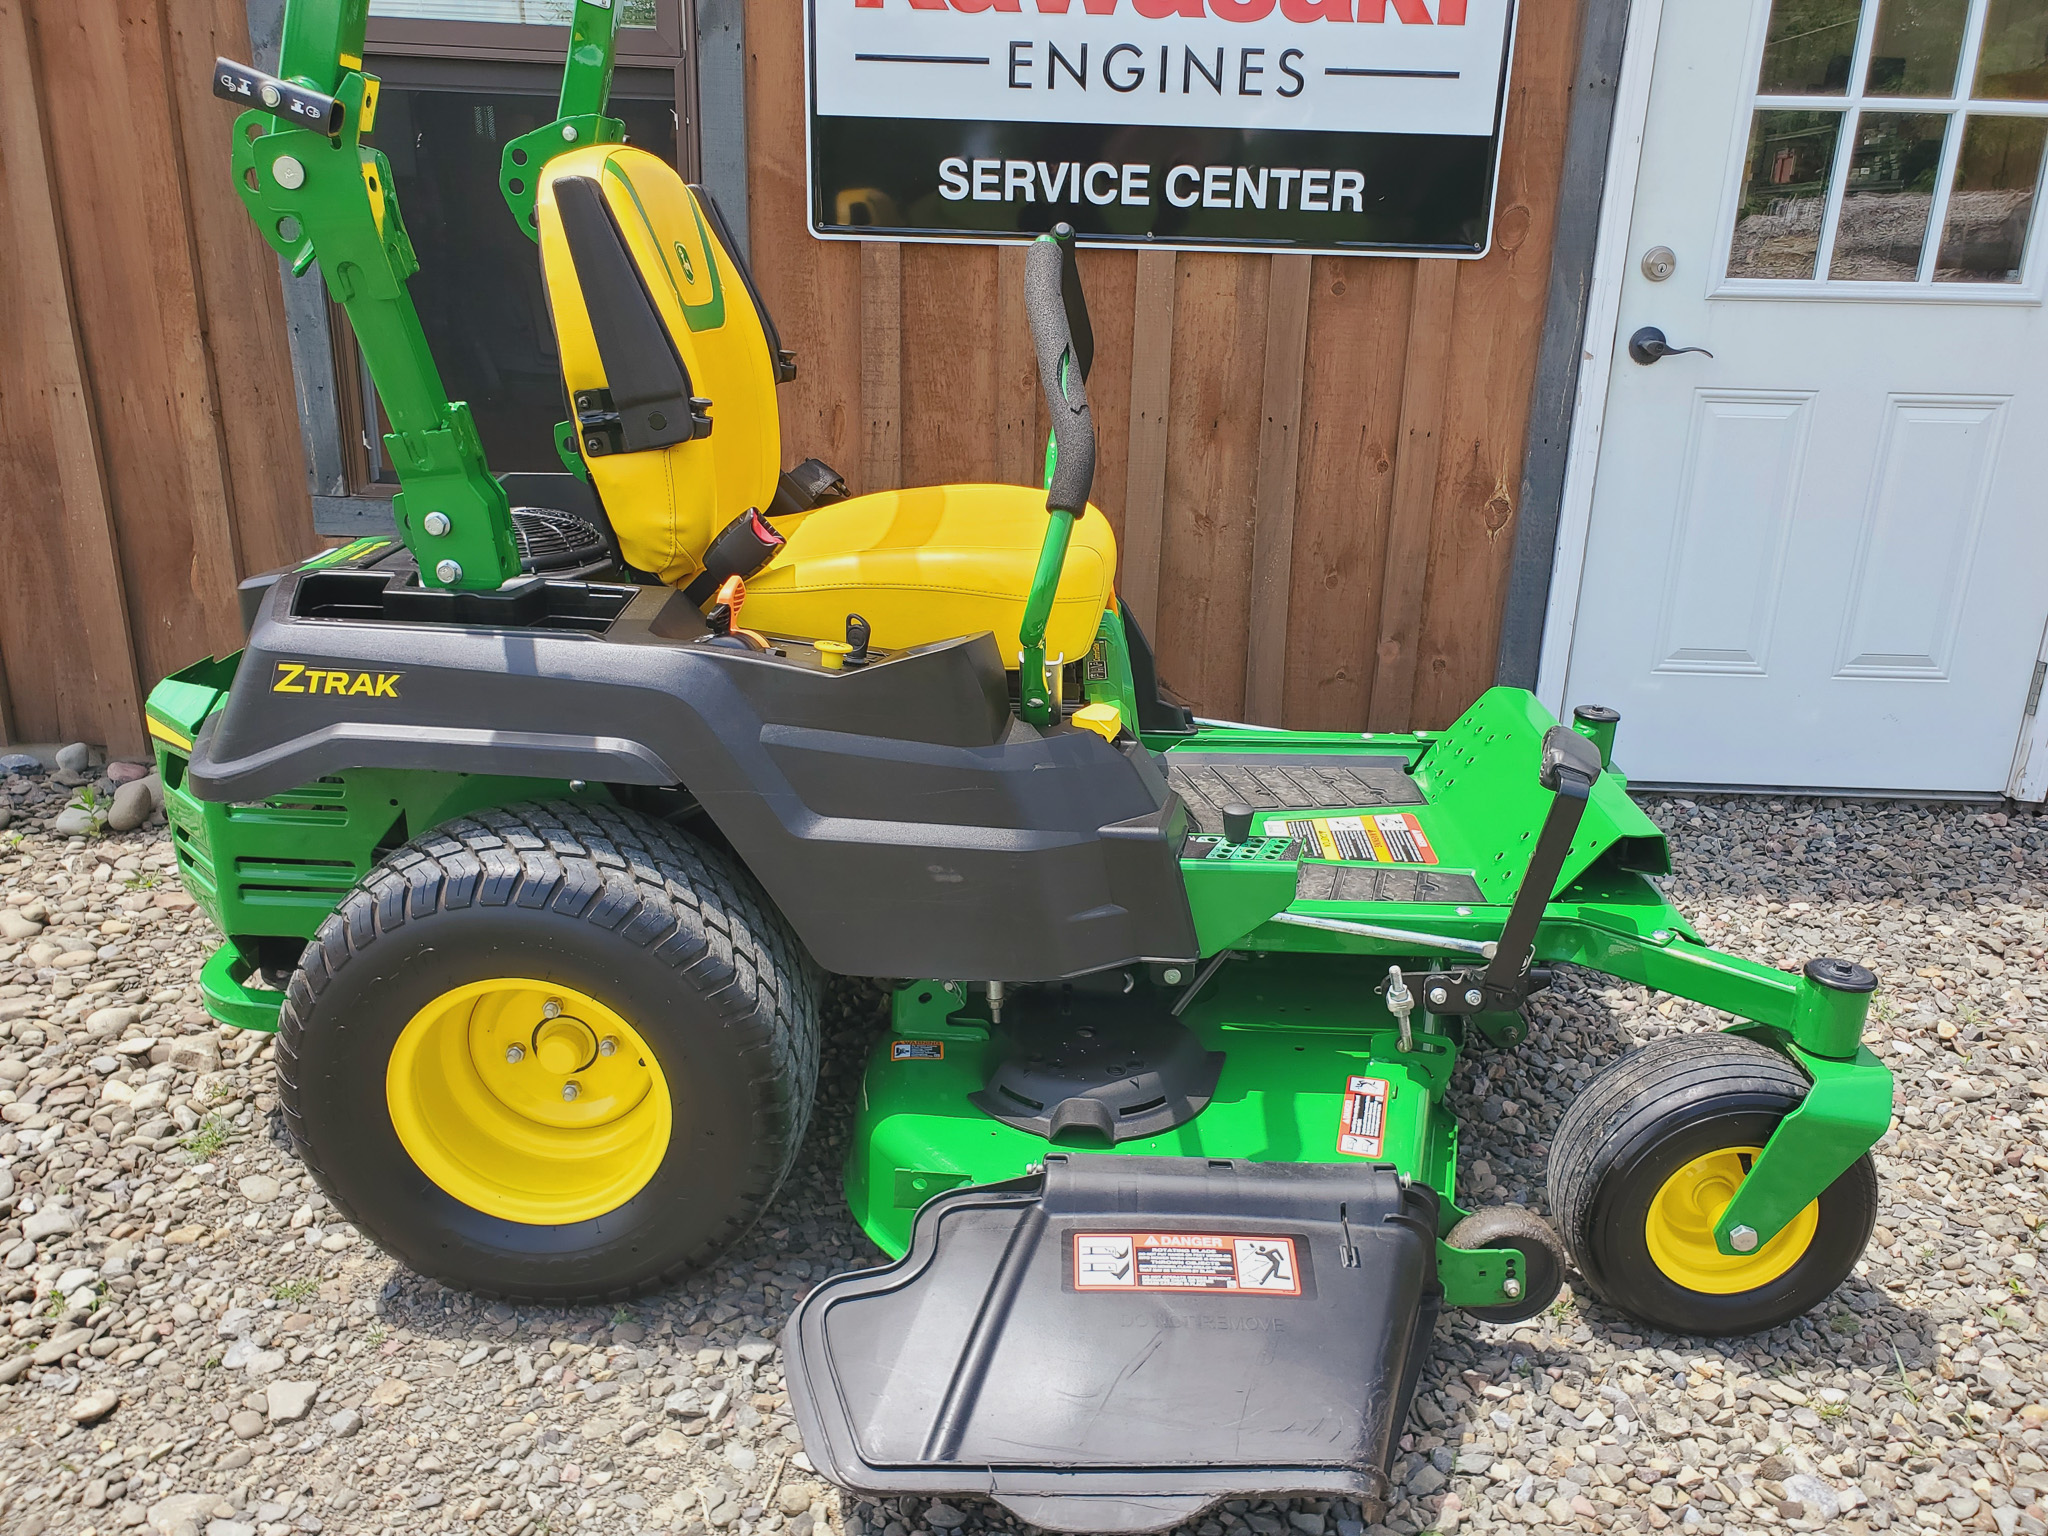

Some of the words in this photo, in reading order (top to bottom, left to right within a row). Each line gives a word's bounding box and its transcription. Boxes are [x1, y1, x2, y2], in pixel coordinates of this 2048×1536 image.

[1008, 40, 1304, 98] ENGINES
[938, 156, 1151, 206] SERVICE
[1165, 163, 1365, 213] CENTER
[273, 663, 400, 698] ZTRAK
[1160, 1236, 1223, 1247] DANGER
[1121, 1313, 1149, 1328] DO
[1155, 1314, 1198, 1329] NOT
[1199, 1315, 1286, 1333] REMOVE
